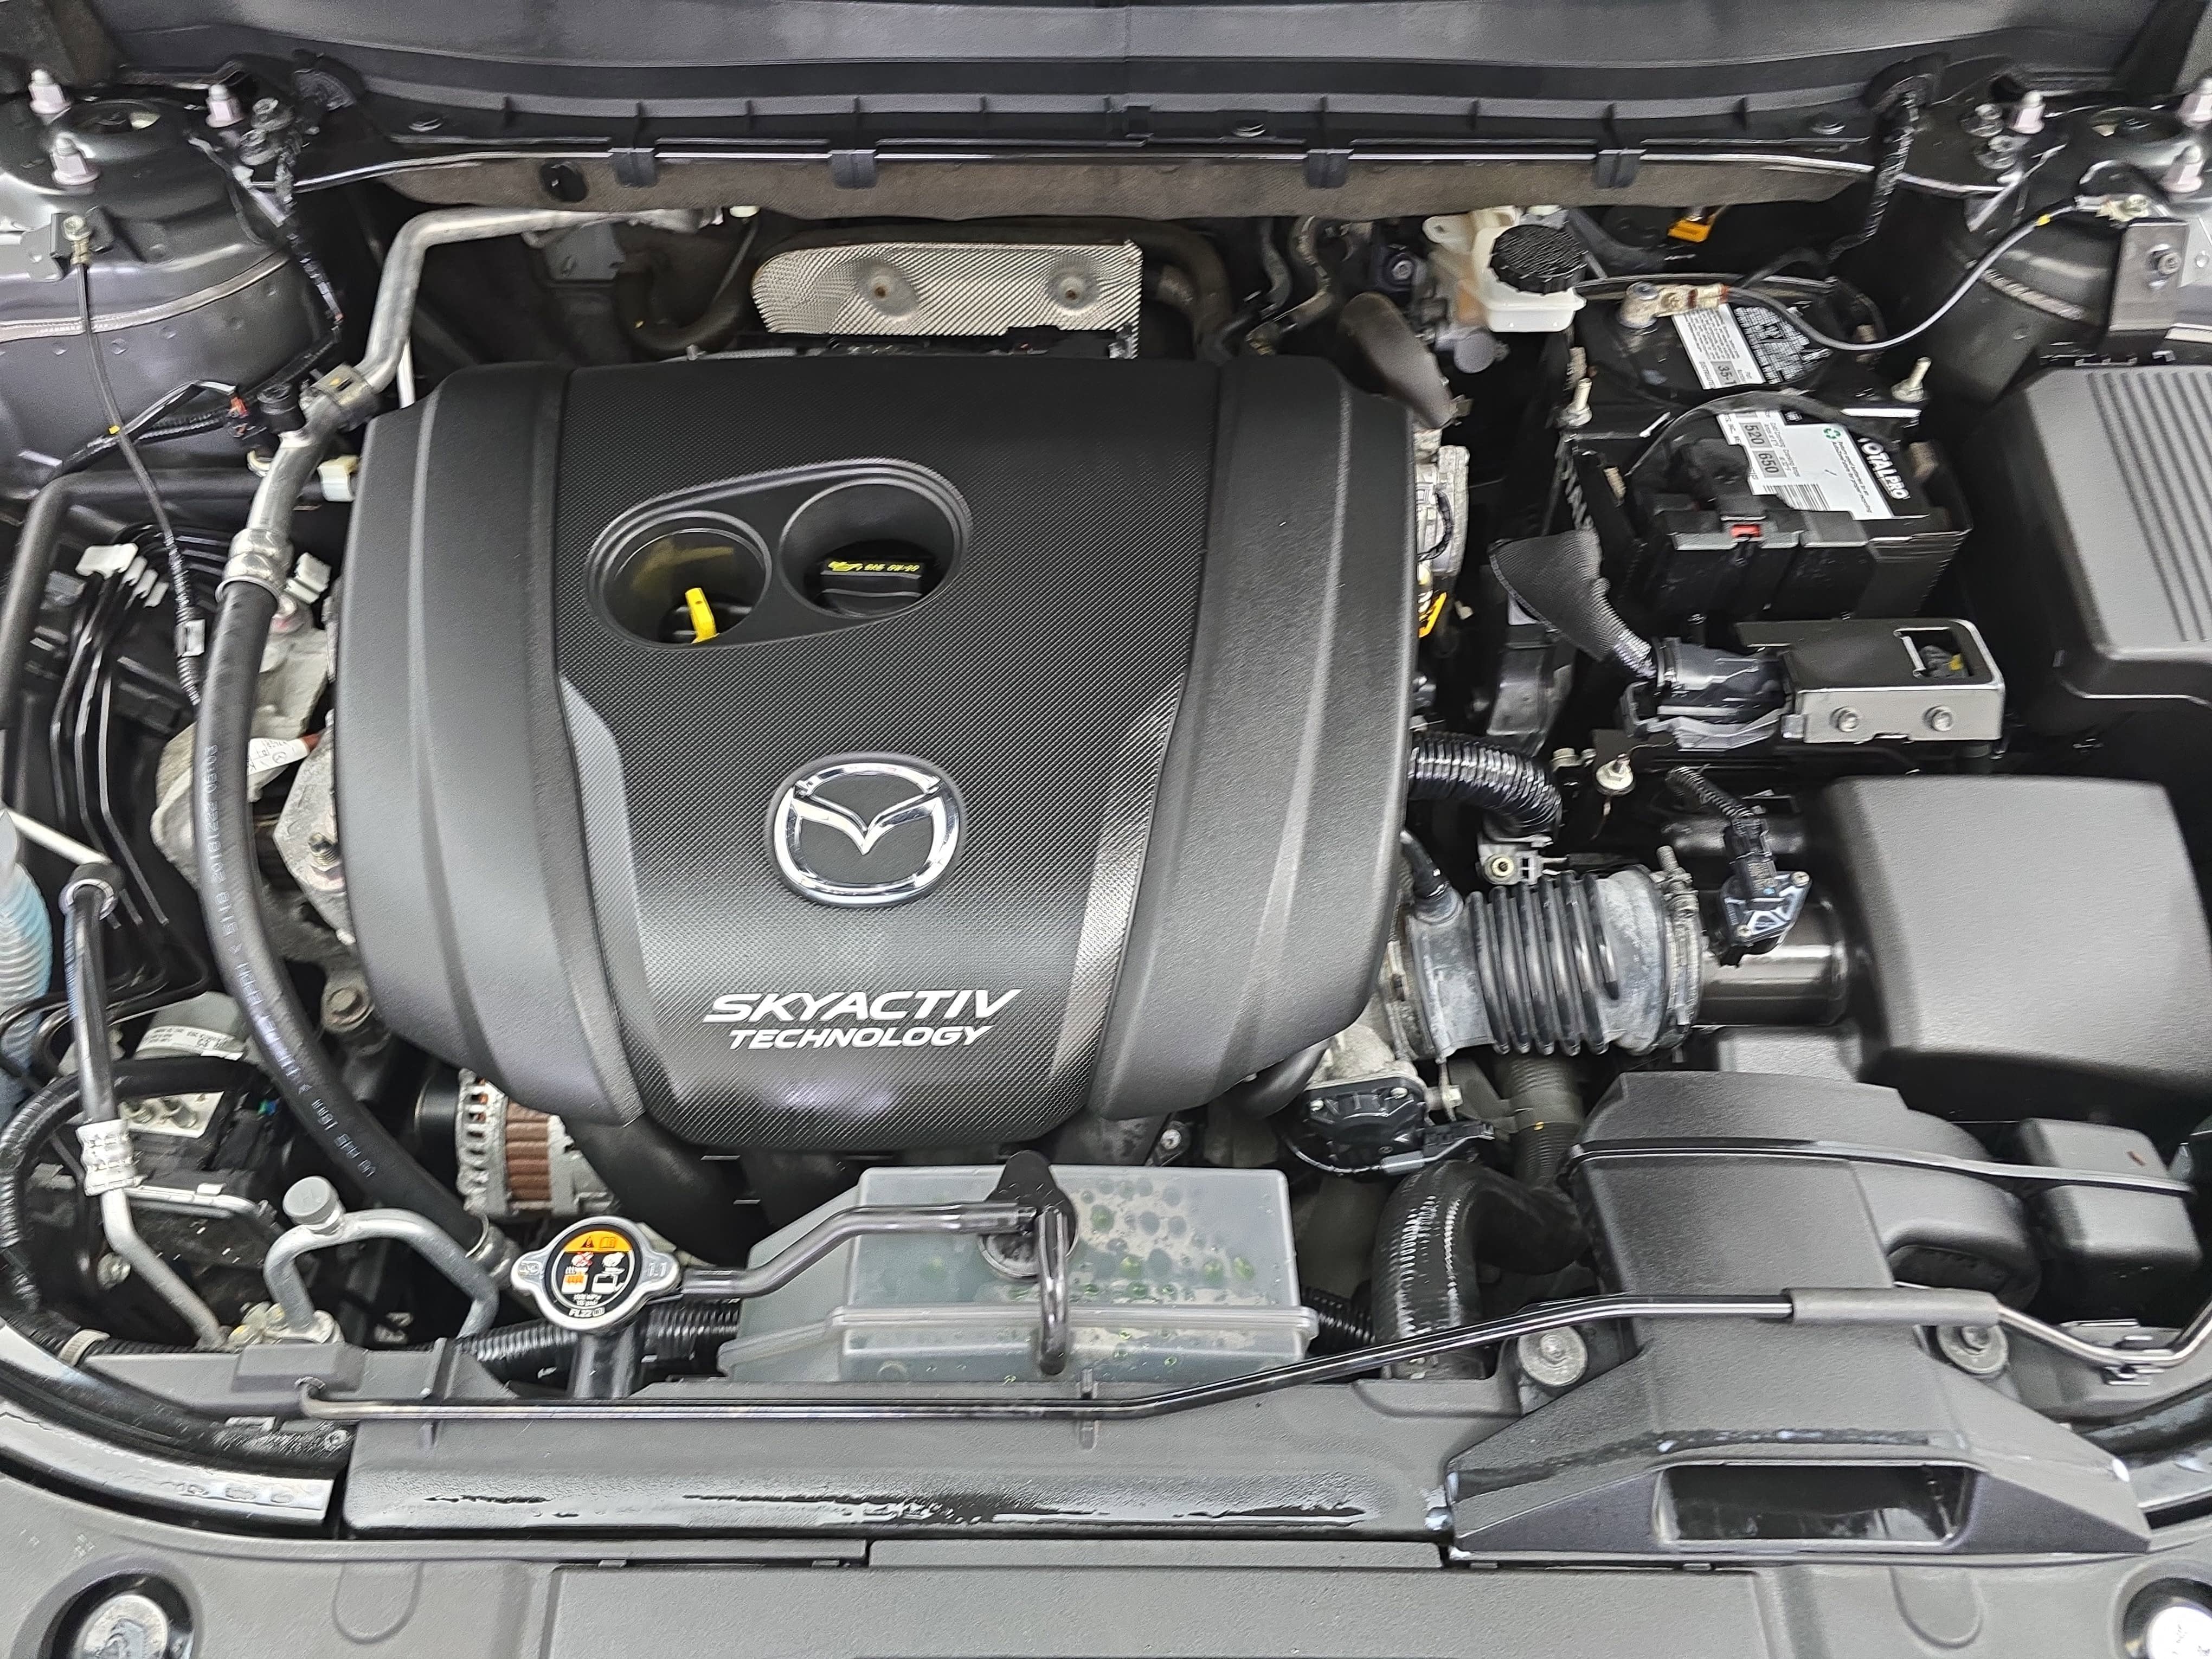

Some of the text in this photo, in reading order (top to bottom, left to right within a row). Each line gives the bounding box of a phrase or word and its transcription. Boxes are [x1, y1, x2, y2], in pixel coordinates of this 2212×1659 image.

[1745, 425, 1765, 445] 520
[1758, 453, 1779, 473] 650
[701, 988, 1025, 1023] SKYACTIV
[729, 1024, 995, 1050] TECHNOLOGY
